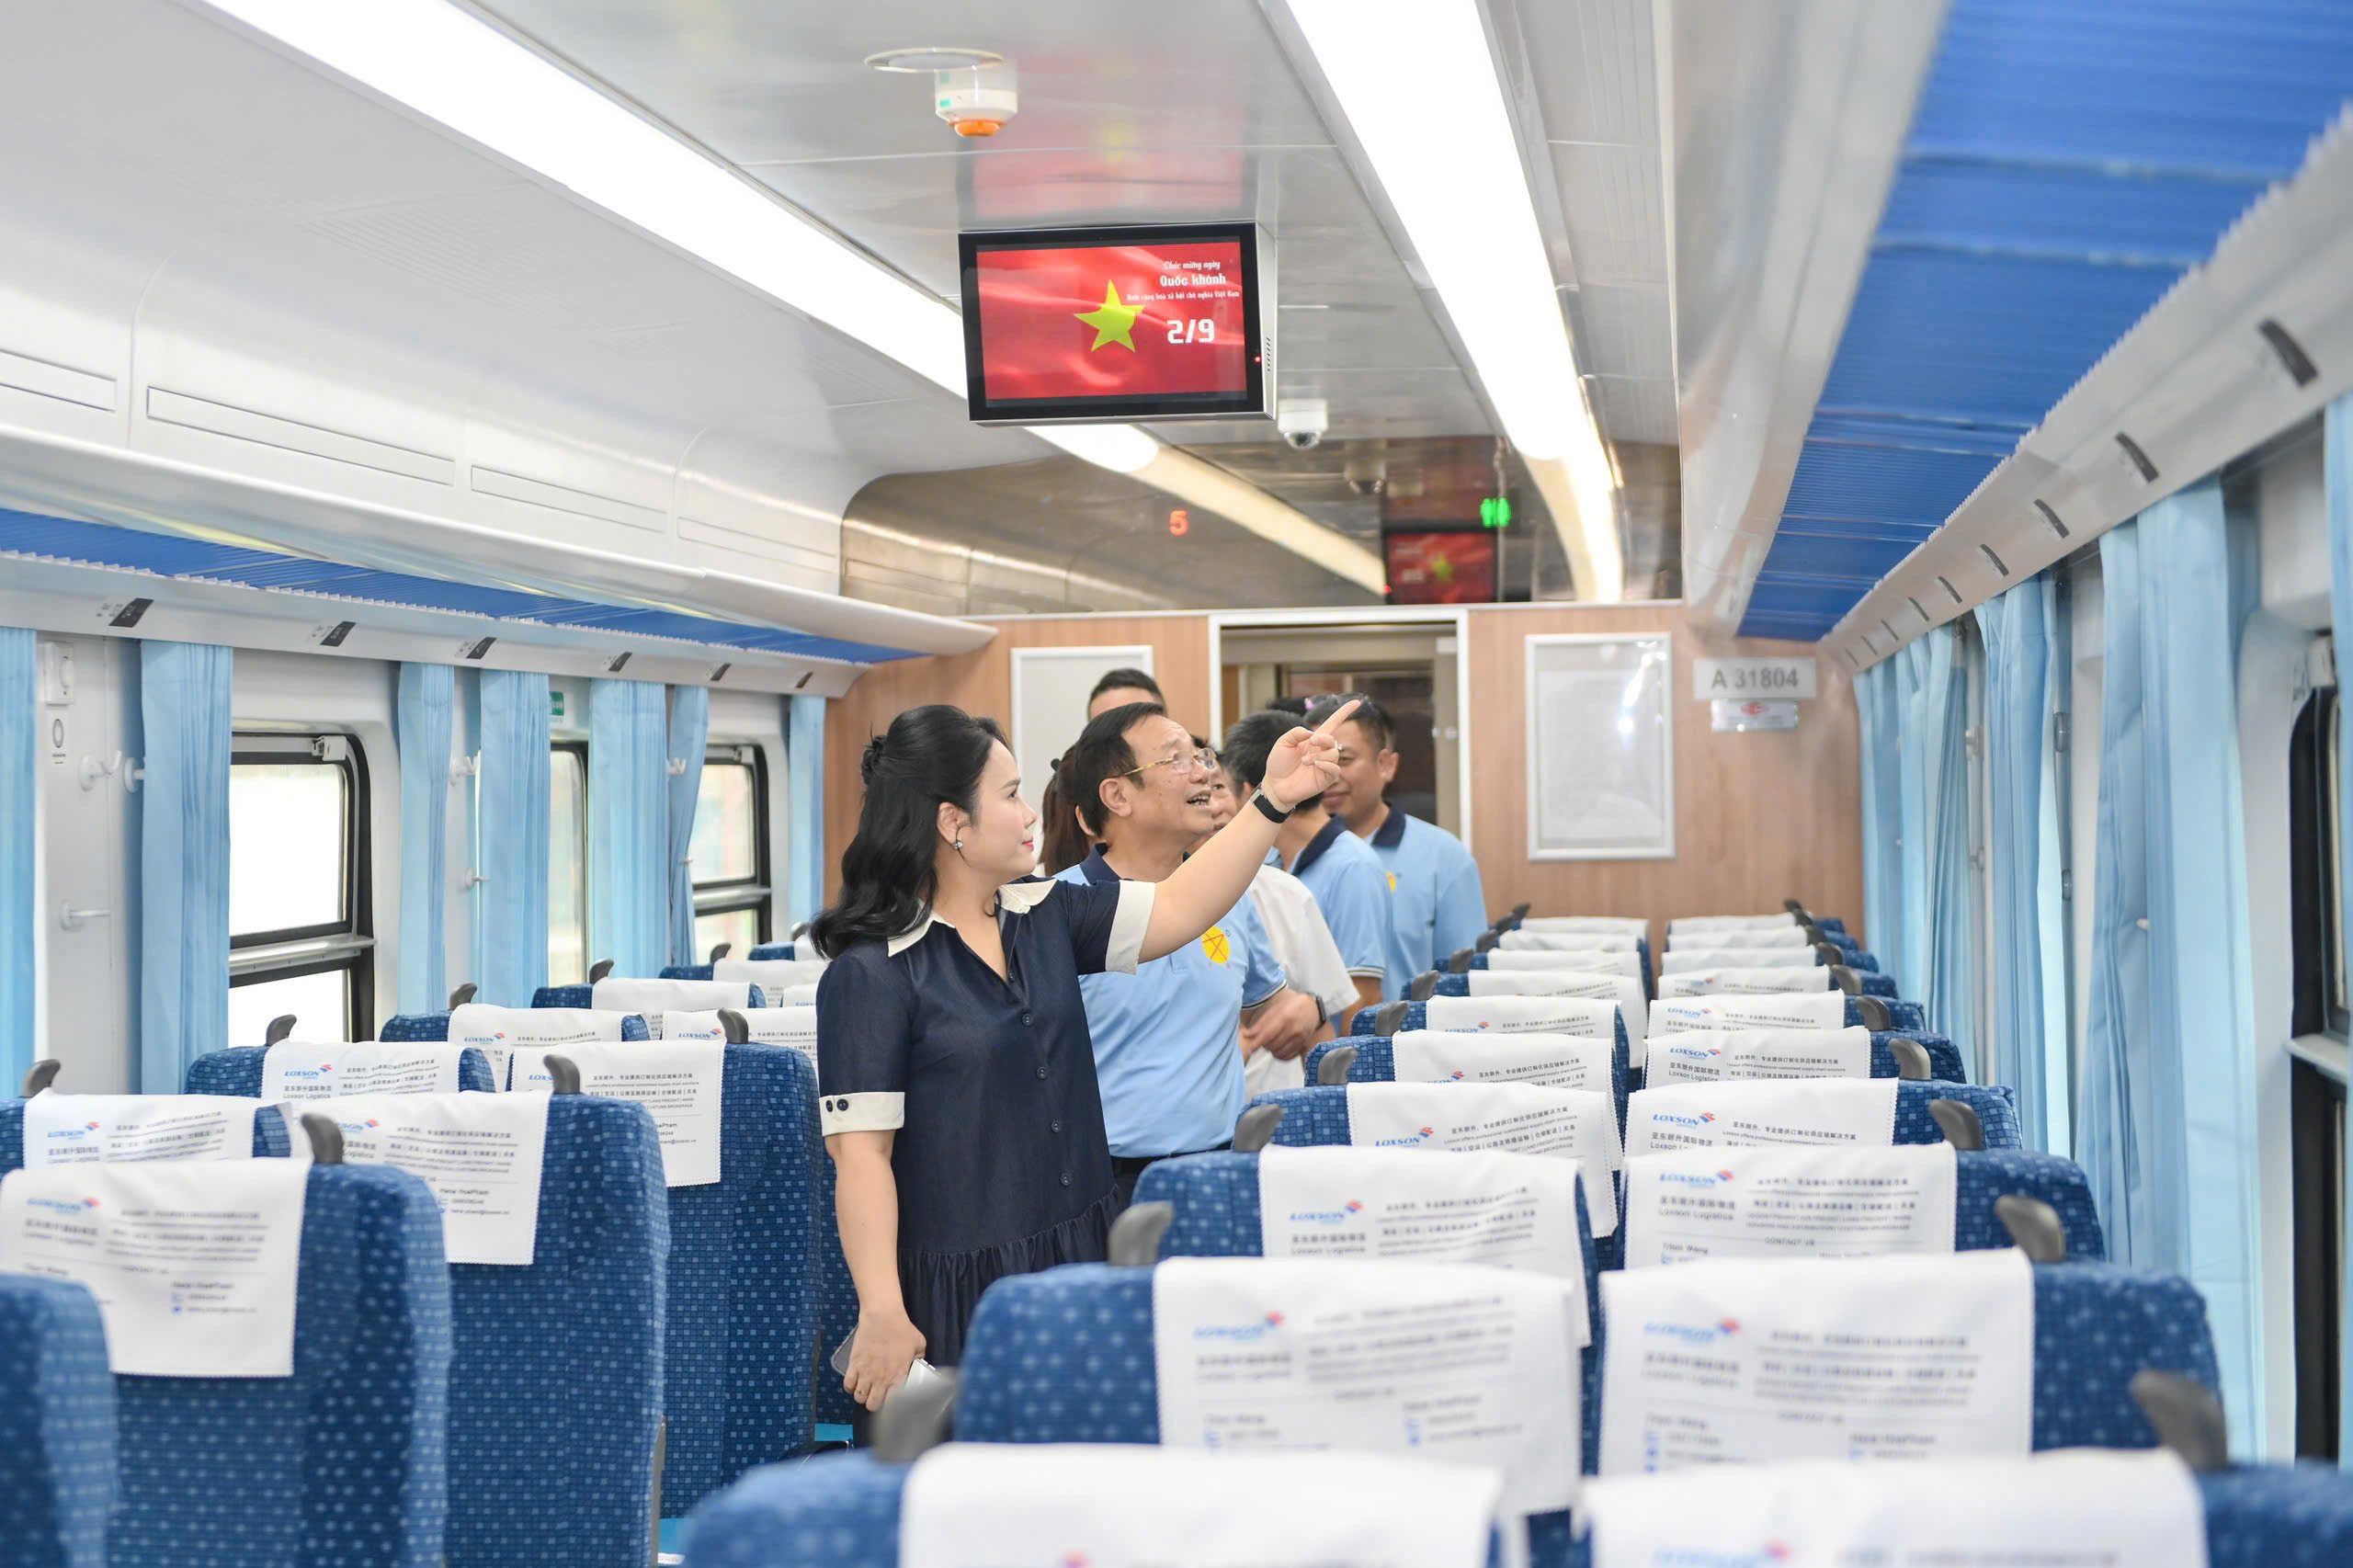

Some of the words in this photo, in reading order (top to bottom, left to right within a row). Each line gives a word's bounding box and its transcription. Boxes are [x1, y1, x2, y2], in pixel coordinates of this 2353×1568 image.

[1203, 260, 1221, 270] ngày
[1160, 274, 1188, 287] Quốc
[1191, 272, 1227, 286] khánh
[1166, 318, 1215, 344] 2/9
[1169, 509, 1188, 537] 5
[1711, 668, 1728, 689] A
[1734, 667, 1800, 690] 31804
[1669, 1047, 1708, 1058] LOXSON
[1669, 1070, 1690, 1078] Loxson
[1653, 1114, 1699, 1126] LOXSON
[1375, 1137, 1420, 1147] LOXSON
[1650, 1142, 1677, 1151] Loxson
